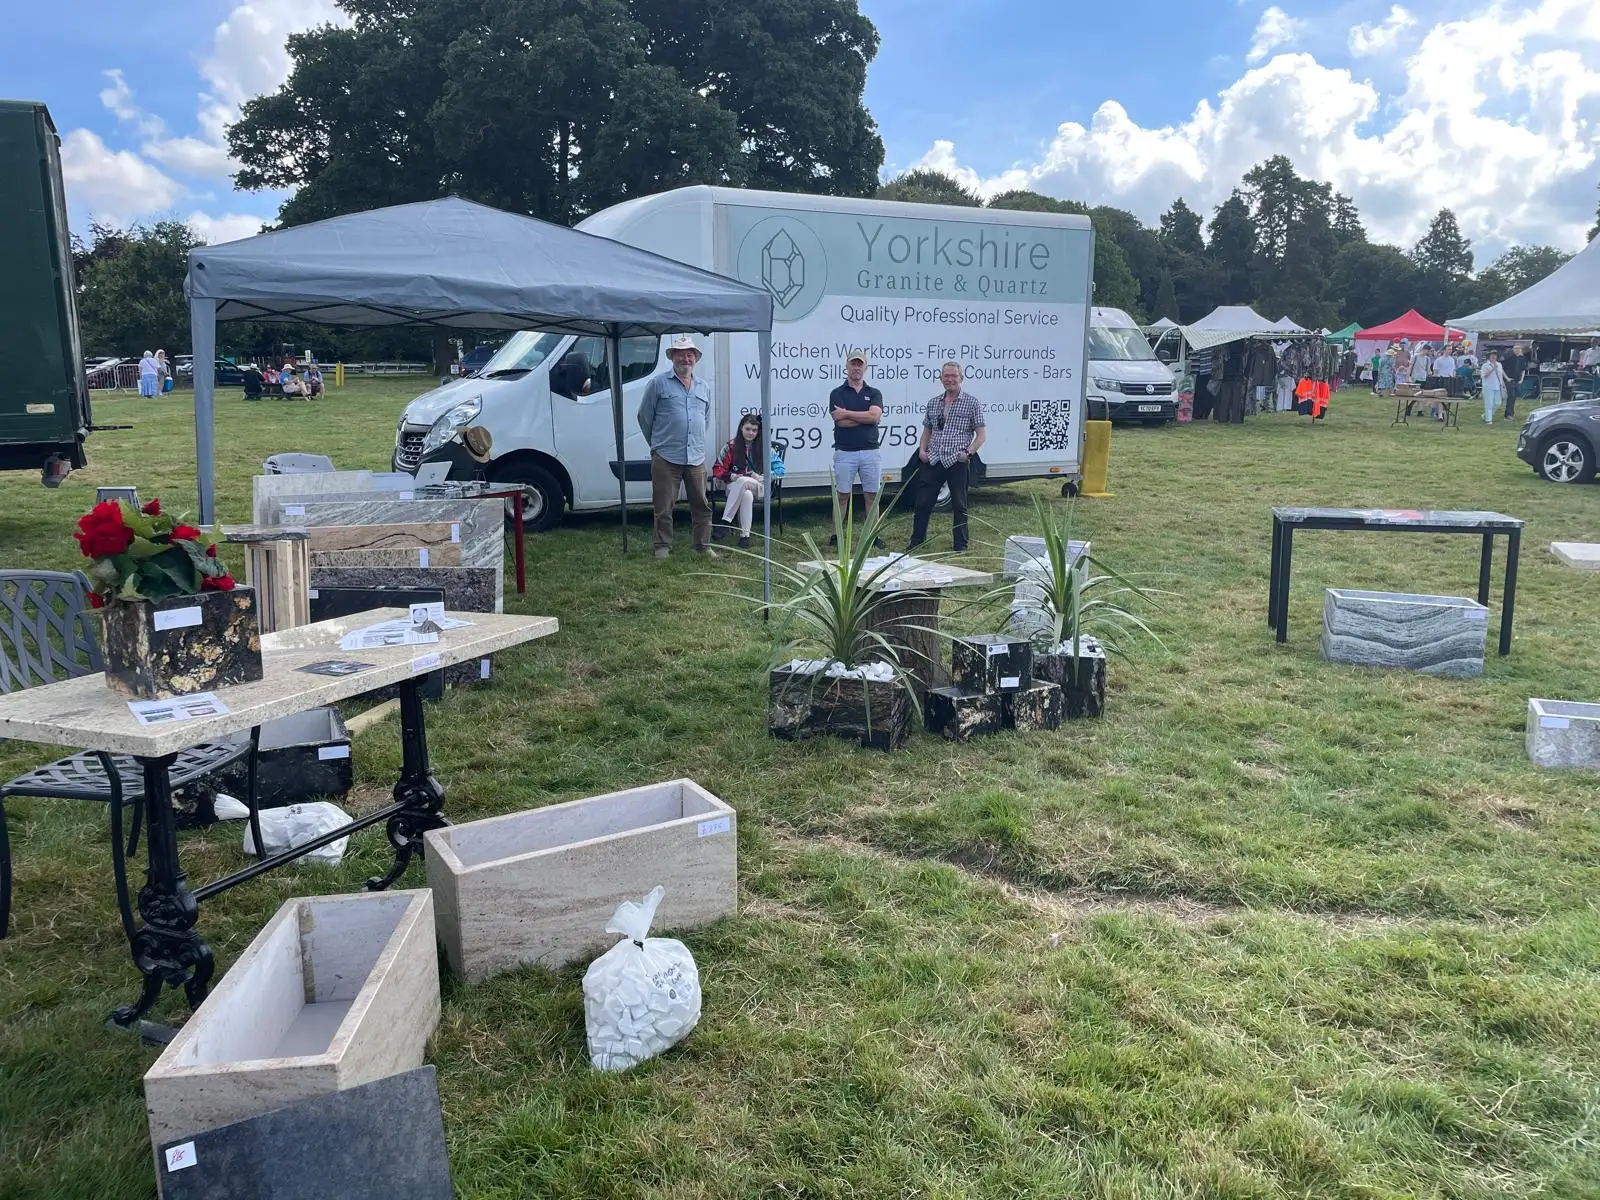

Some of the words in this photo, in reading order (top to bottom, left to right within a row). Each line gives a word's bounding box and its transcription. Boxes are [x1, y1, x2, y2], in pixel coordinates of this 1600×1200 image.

[857, 222, 1050, 271] Yorkshire
[857, 269, 944, 291] Granite
[954, 274, 968, 292] &
[978, 275, 1048, 298] Quartz
[840, 304, 900, 326] Quality
[904, 306, 999, 325] Professional
[1004, 309, 1059, 326] Service
[928, 344, 956, 360] Fire
[960, 345, 980, 360] Pit
[983, 345, 1056, 361] Surrounds
[744, 363, 814, 380] Wndow
[867, 364, 909, 380] Table
[964, 365, 1029, 380] Counters
[1043, 365, 1072, 380] Bars
